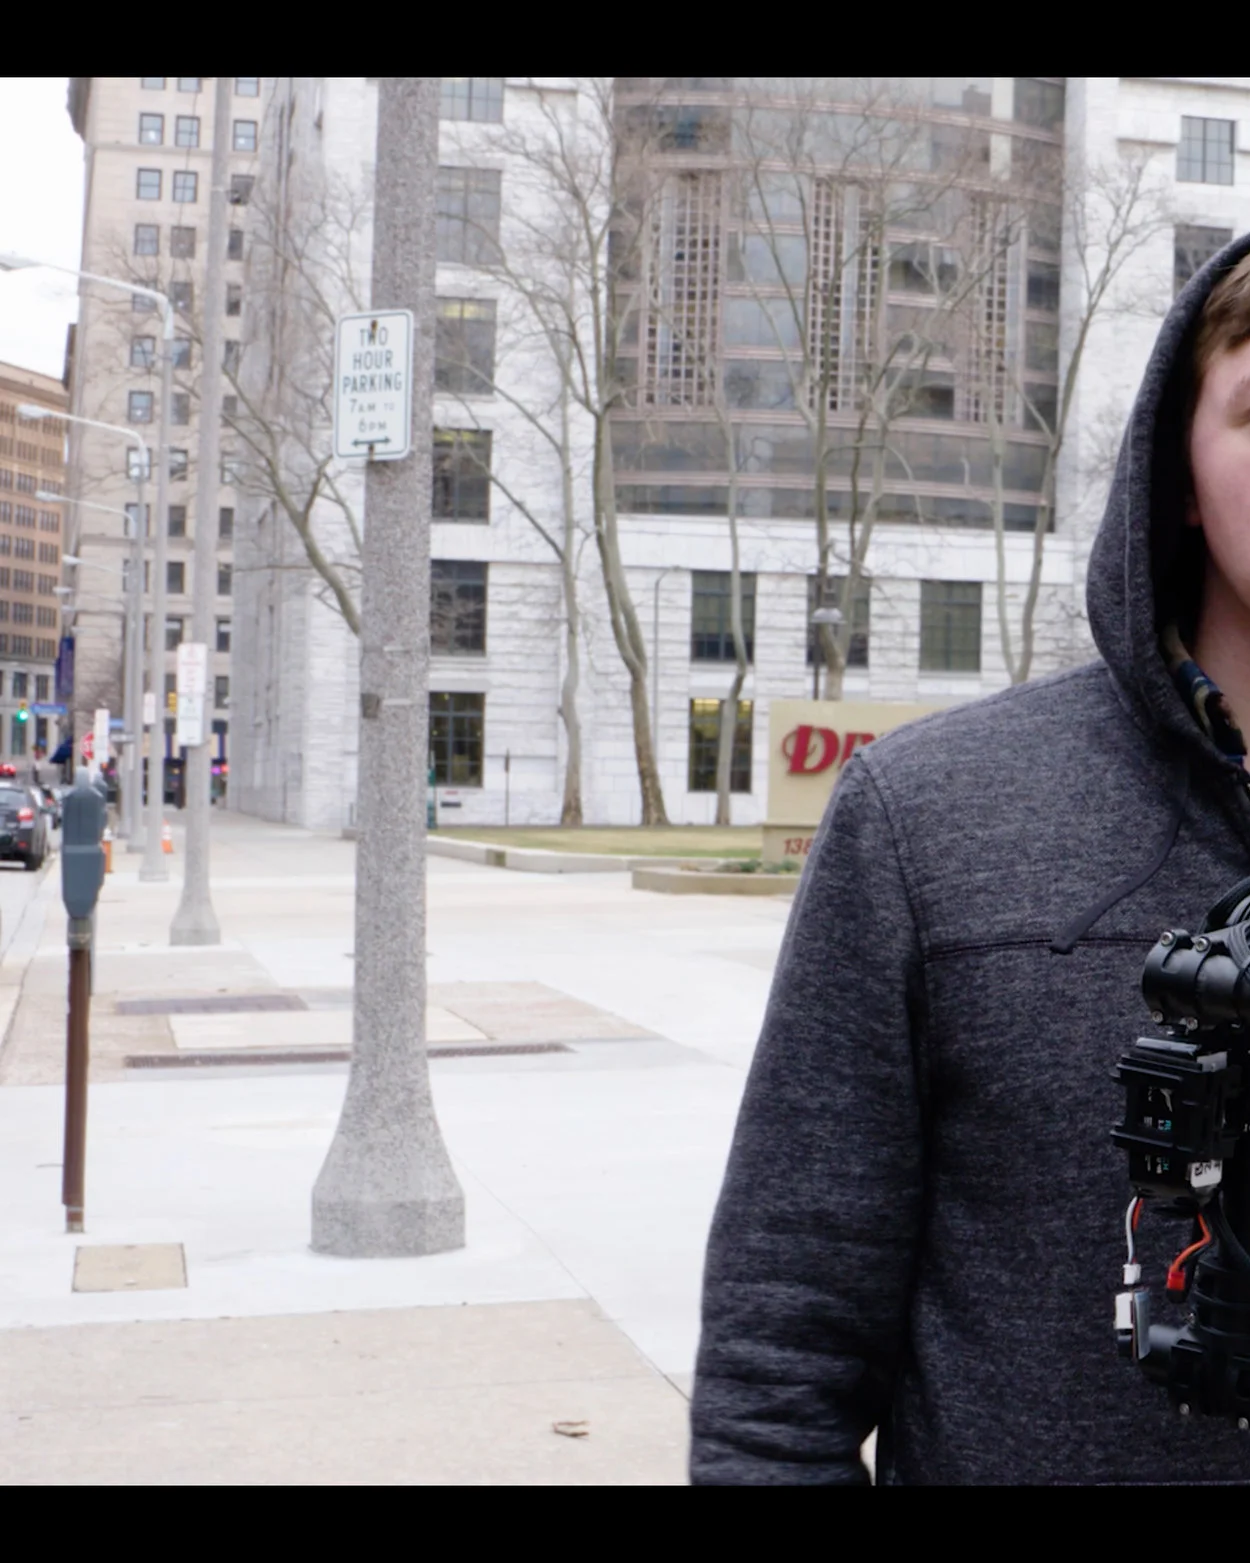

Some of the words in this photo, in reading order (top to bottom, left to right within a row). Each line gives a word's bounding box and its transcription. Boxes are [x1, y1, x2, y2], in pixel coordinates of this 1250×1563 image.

[360, 326, 388, 347] TWO
[352, 350, 393, 371] HOUR
[342, 372, 402, 395] PARKING
